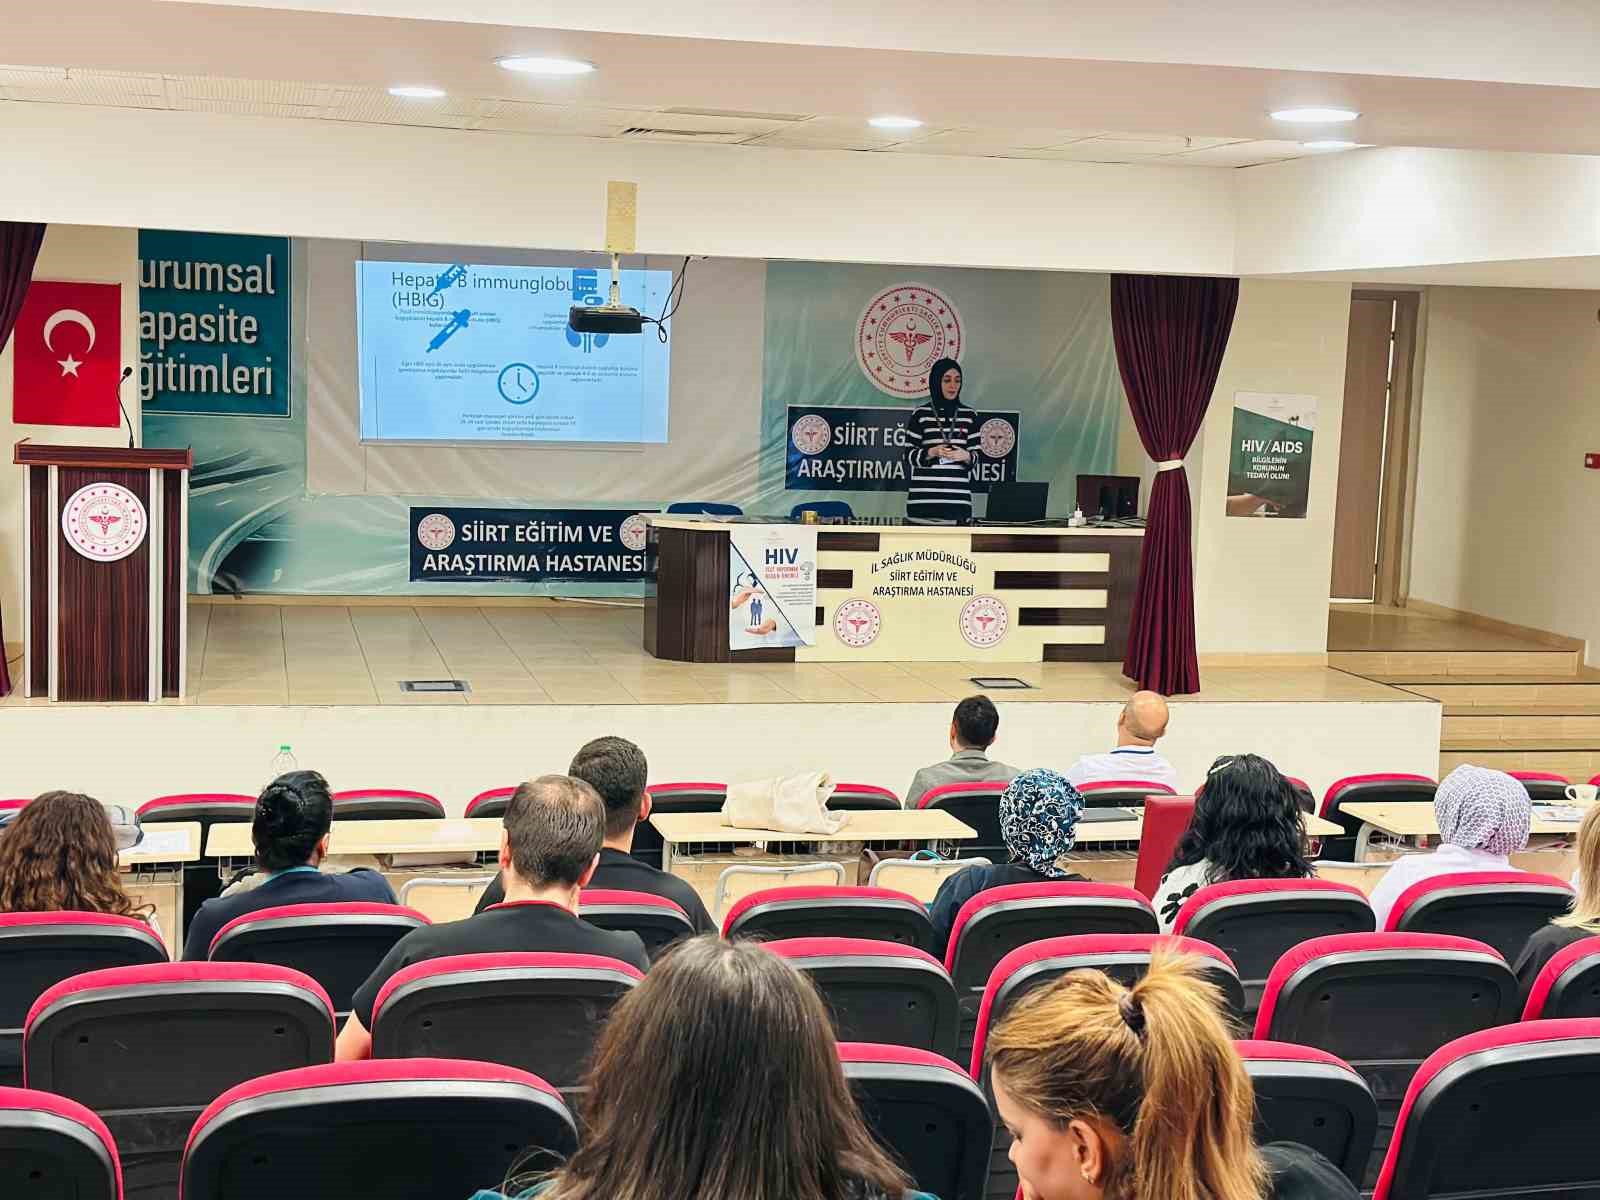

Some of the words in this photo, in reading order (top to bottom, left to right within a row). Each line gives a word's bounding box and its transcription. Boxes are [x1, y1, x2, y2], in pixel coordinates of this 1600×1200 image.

[138, 253, 275, 295] urumsal
[392, 272, 441, 290] Hepa
[392, 292, 445, 310] (HBIG)
[139, 304, 258, 350] apasite
[140, 352, 272, 401] ğitimleri
[1241, 439, 1304, 454] HIV/AIDS
[797, 459, 905, 482] ARAŞTIRMA
[461, 521, 509, 542] SİİRT
[514, 521, 583, 543] EĞİTİM
[588, 525, 613, 543] VE
[422, 553, 540, 576] ARAŞTIRMA
[546, 552, 647, 572] HASTANESİ
[765, 548, 799, 565] HIV
[880, 551, 914, 569] SAĞLIK
[915, 548, 977, 574] MÜDÜRLÜĞÜ
[913, 569, 944, 581] EĞİTİM
[946, 571, 958, 581] VE
[872, 586, 925, 598] ARAŞTIRMA
[926, 584, 974, 597] HASTANESİ
